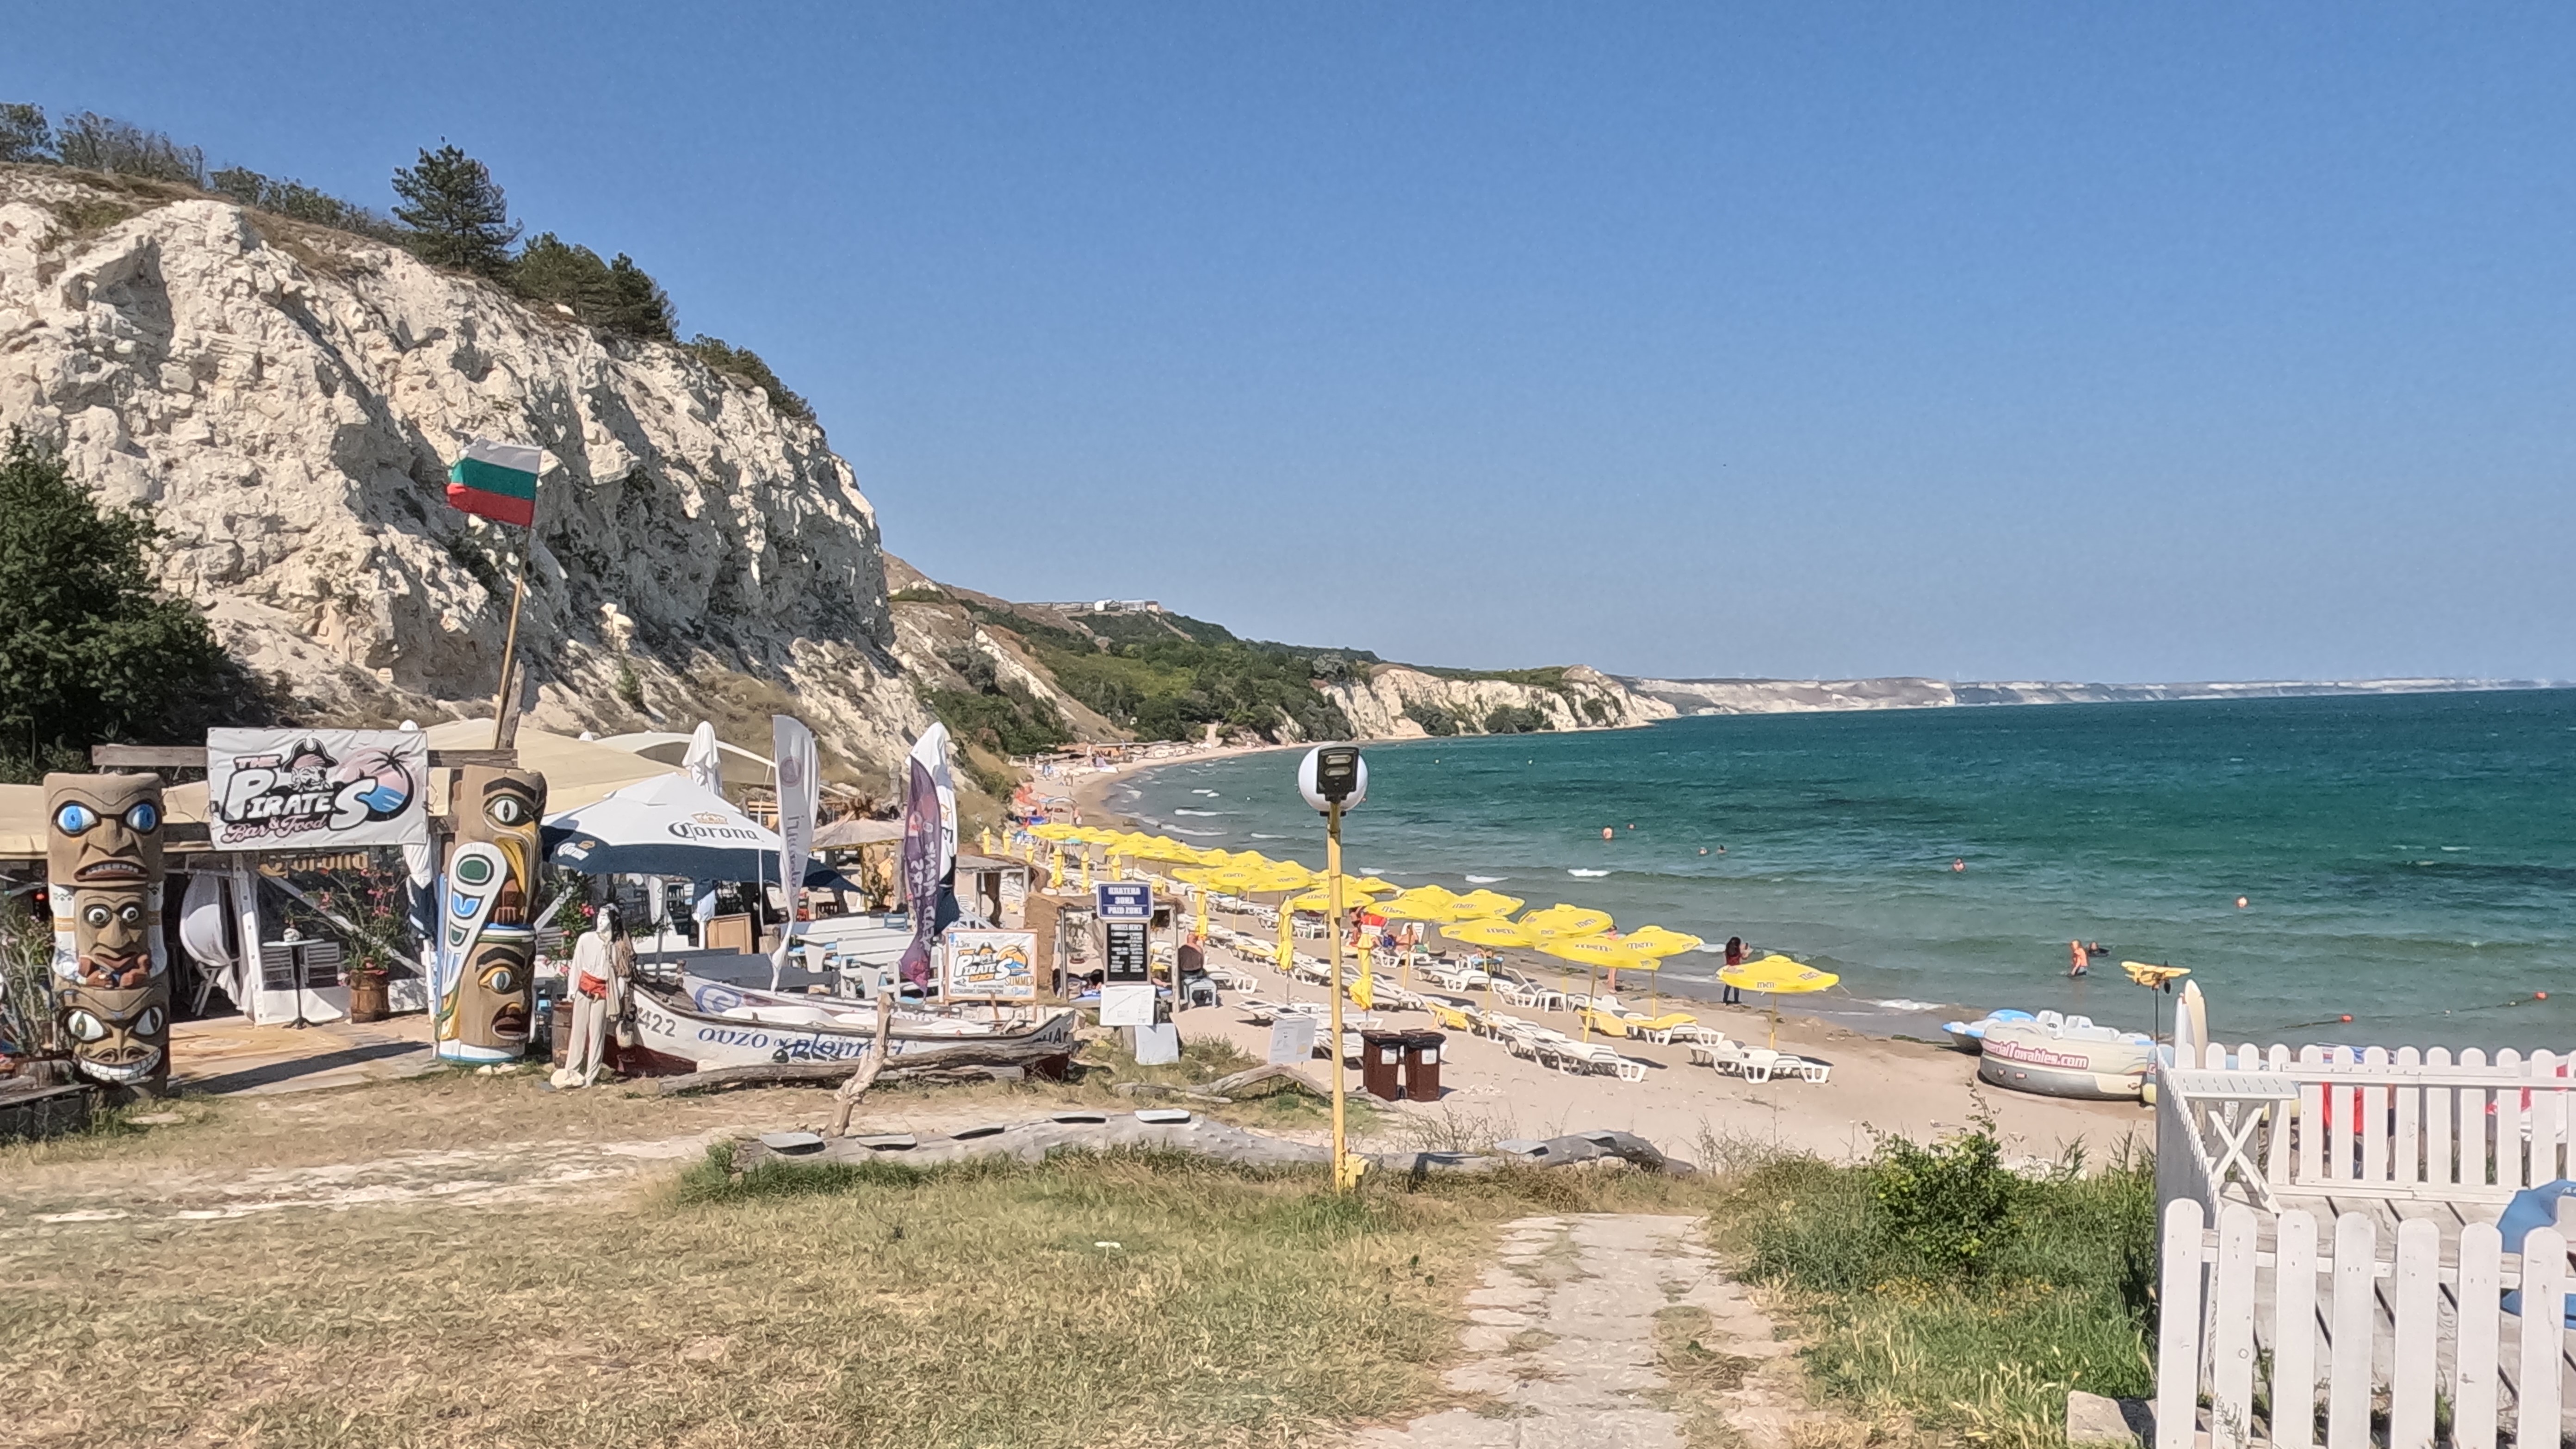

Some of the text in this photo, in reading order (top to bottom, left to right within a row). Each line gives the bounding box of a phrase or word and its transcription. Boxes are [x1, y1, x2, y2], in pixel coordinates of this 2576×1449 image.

[235, 757, 280, 769] THE
[222, 768, 377, 830] PIRATES
[221, 814, 327, 843] Bar & Food
[668, 822, 760, 841] Corona
[955, 955, 1011, 980] PIRATES
[1004, 976, 1034, 986] SUMMER
